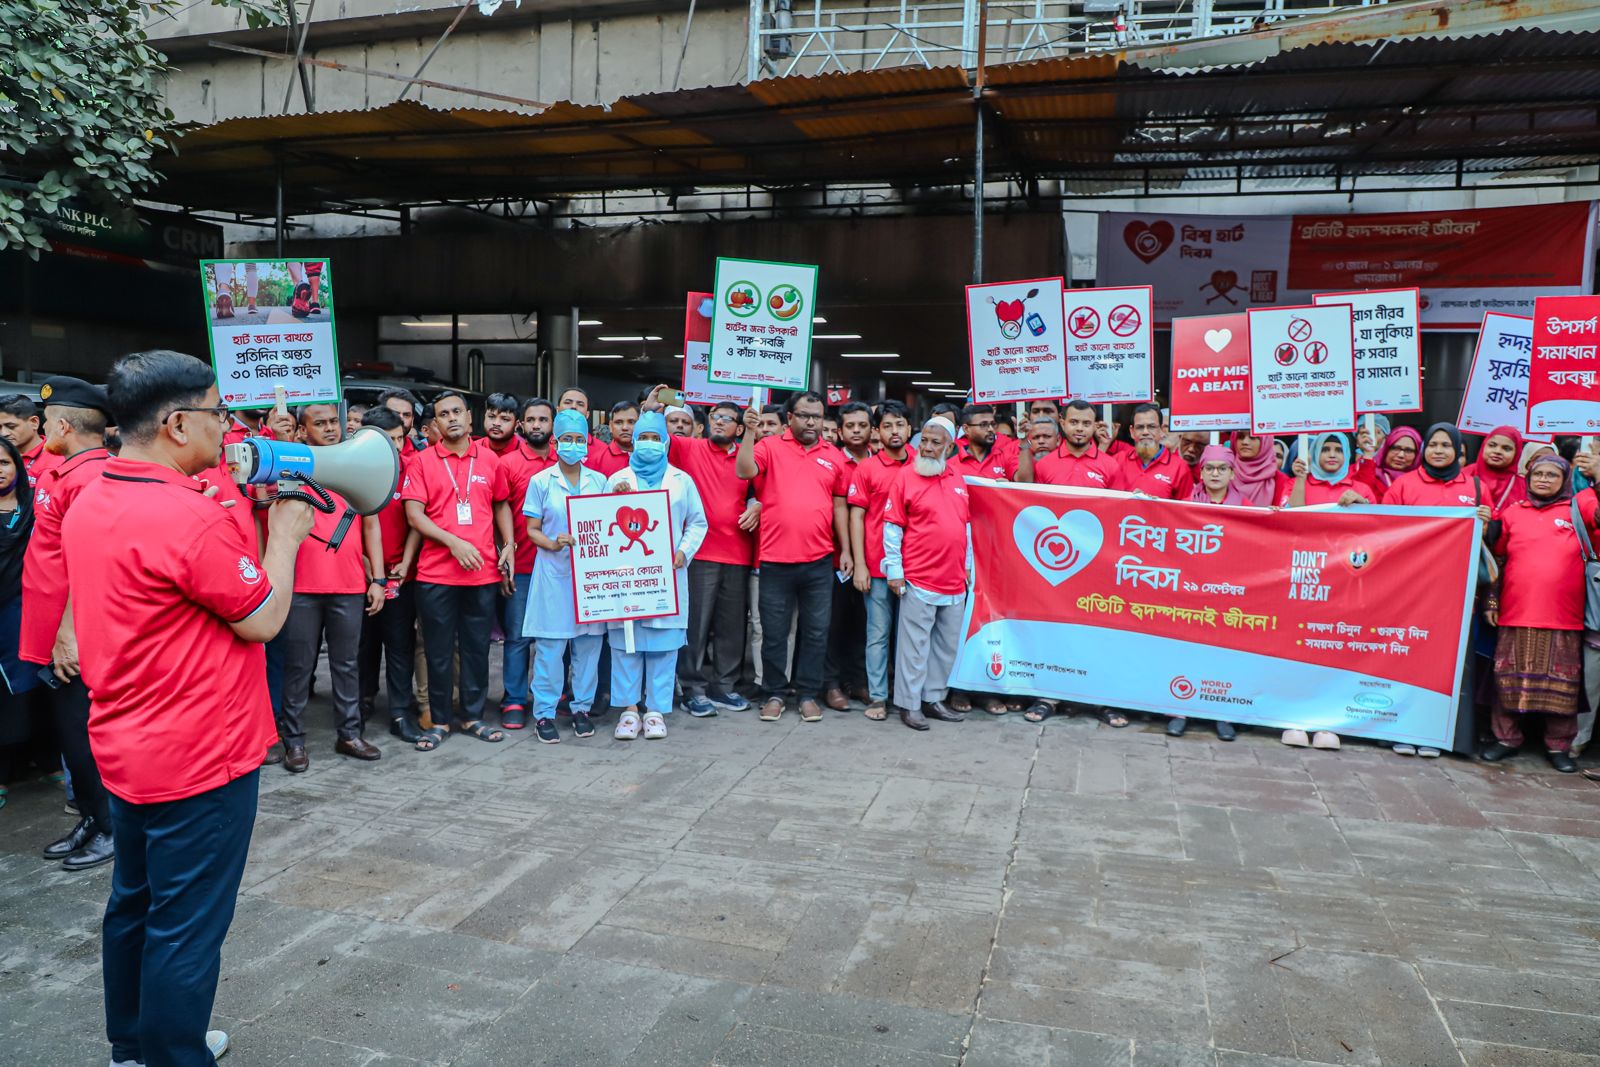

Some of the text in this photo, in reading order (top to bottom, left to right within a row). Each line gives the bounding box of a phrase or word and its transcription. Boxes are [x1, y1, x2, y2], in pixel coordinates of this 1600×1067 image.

[84, 212, 112, 229] PLC.
[1181, 225, 1212, 242] বিশ্ব
[163, 226, 218, 259] CRM
[1180, 246, 1212, 257] দিবস
[1375, 304, 1405, 320] নীরব
[1546, 316, 1598, 334] উপসর্গ
[254, 334, 280, 343] ভালো
[284, 333, 314, 342] রাখতে
[1374, 324, 1413, 342] লুকিয়ে
[236, 348, 313, 363] প্রতিদিন অন্তত
[727, 348, 734, 356] ও
[1368, 347, 1398, 360] সবার
[1537, 345, 1598, 361] সমাধান
[231, 370, 251, 378] ৩০
[255, 364, 288, 377] মিনিট
[1177, 365, 1249, 379] DON'T MIS
[1285, 373, 1307, 381] ভালো
[1310, 371, 1336, 379] রাখতে
[1547, 370, 1597, 388] ব্যবস্থা
[1188, 380, 1244, 393] A BEAT!
[578, 519, 602, 533] DON'T
[579, 533, 600, 546] MISS
[1119, 514, 1225, 555] বিশ্ব হার্ট
[580, 545, 609, 558] A BEAT
[1292, 550, 1328, 569] DON'T
[637, 566, 663, 575] কোনো
[1115, 556, 1182, 591] দিবস
[1183, 581, 1199, 593] ২৯
[1290, 567, 1321, 585] MISS
[602, 581, 619, 590] যেন
[621, 580, 632, 588] না
[1288, 583, 1332, 602] A BEAT
[1076, 593, 1126, 613] প্রতিটি
[1130, 600, 1218, 628] হৃদস্পন্দনই
[1336, 621, 1363, 637] চিনুন
[1200, 687, 1229, 695] HEART
[1201, 680, 1233, 689] WORLD
[1200, 694, 1254, 706] FEDERATION
